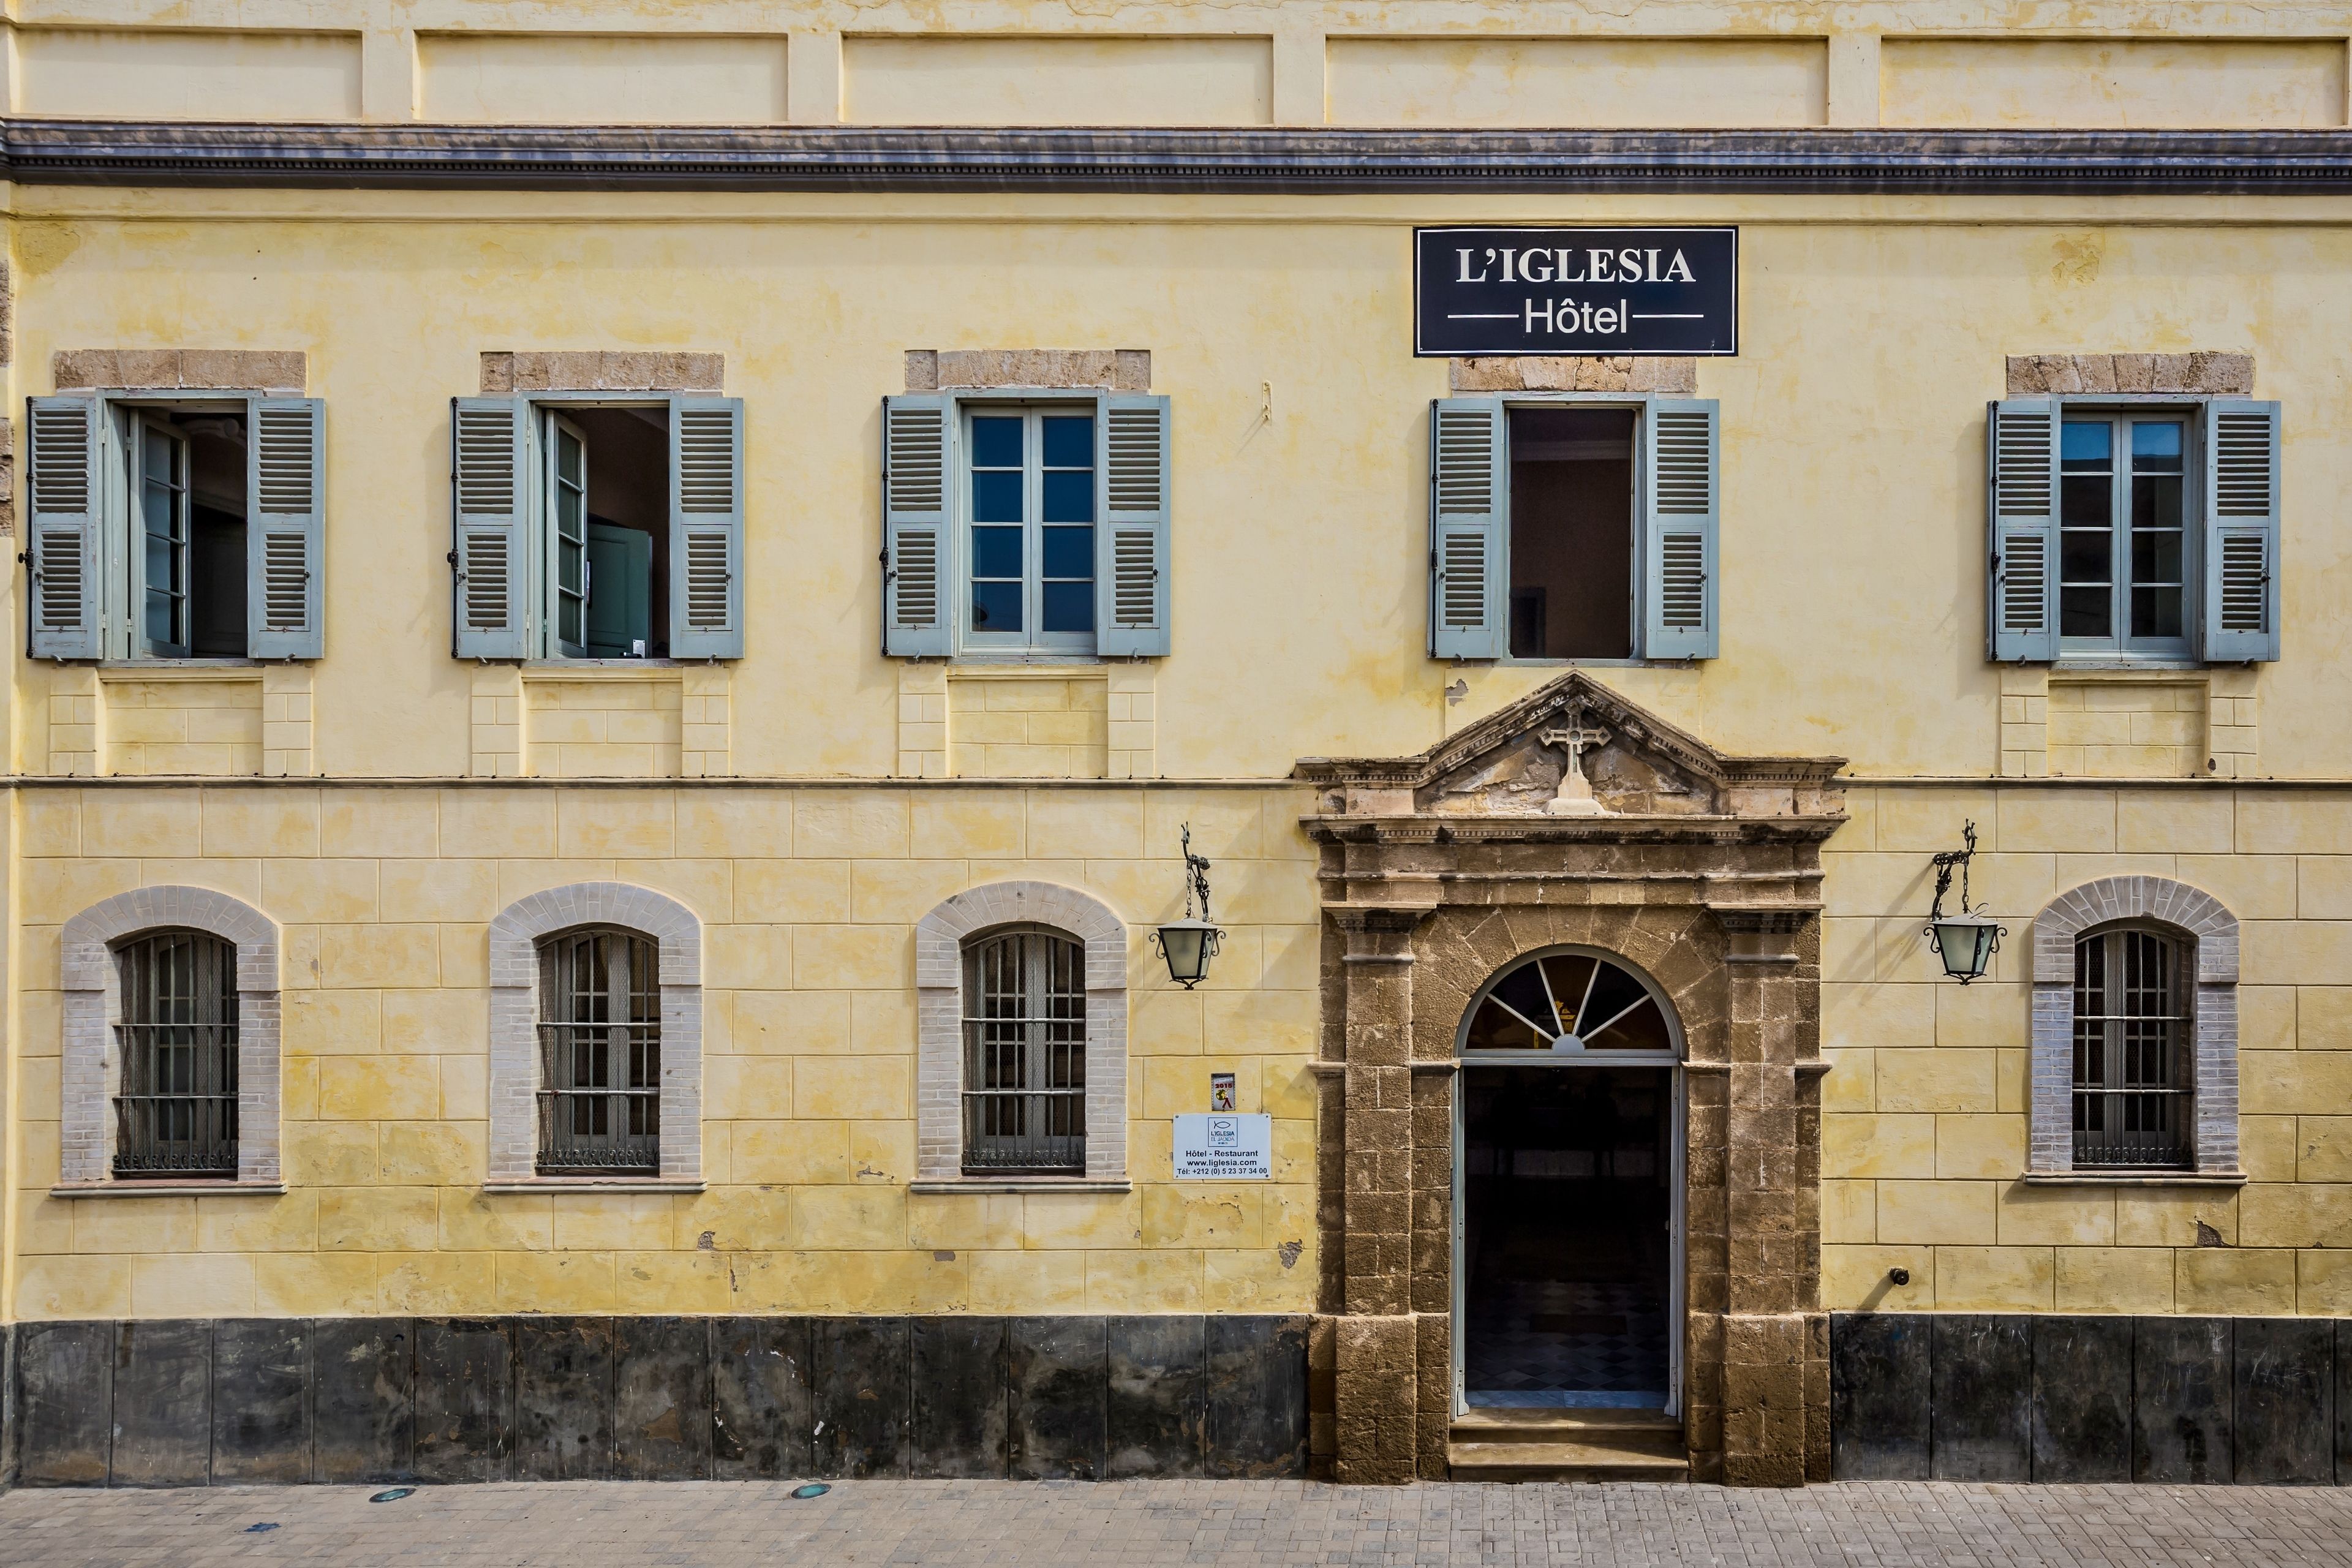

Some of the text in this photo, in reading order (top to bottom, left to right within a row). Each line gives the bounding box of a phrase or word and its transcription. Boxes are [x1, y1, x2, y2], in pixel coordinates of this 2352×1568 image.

[1455, 247, 1697, 283] L'IGLESIA
[1525, 298, 1627, 334] Hôtel
[1187, 1159, 1257, 1167] www.liglesia.com
